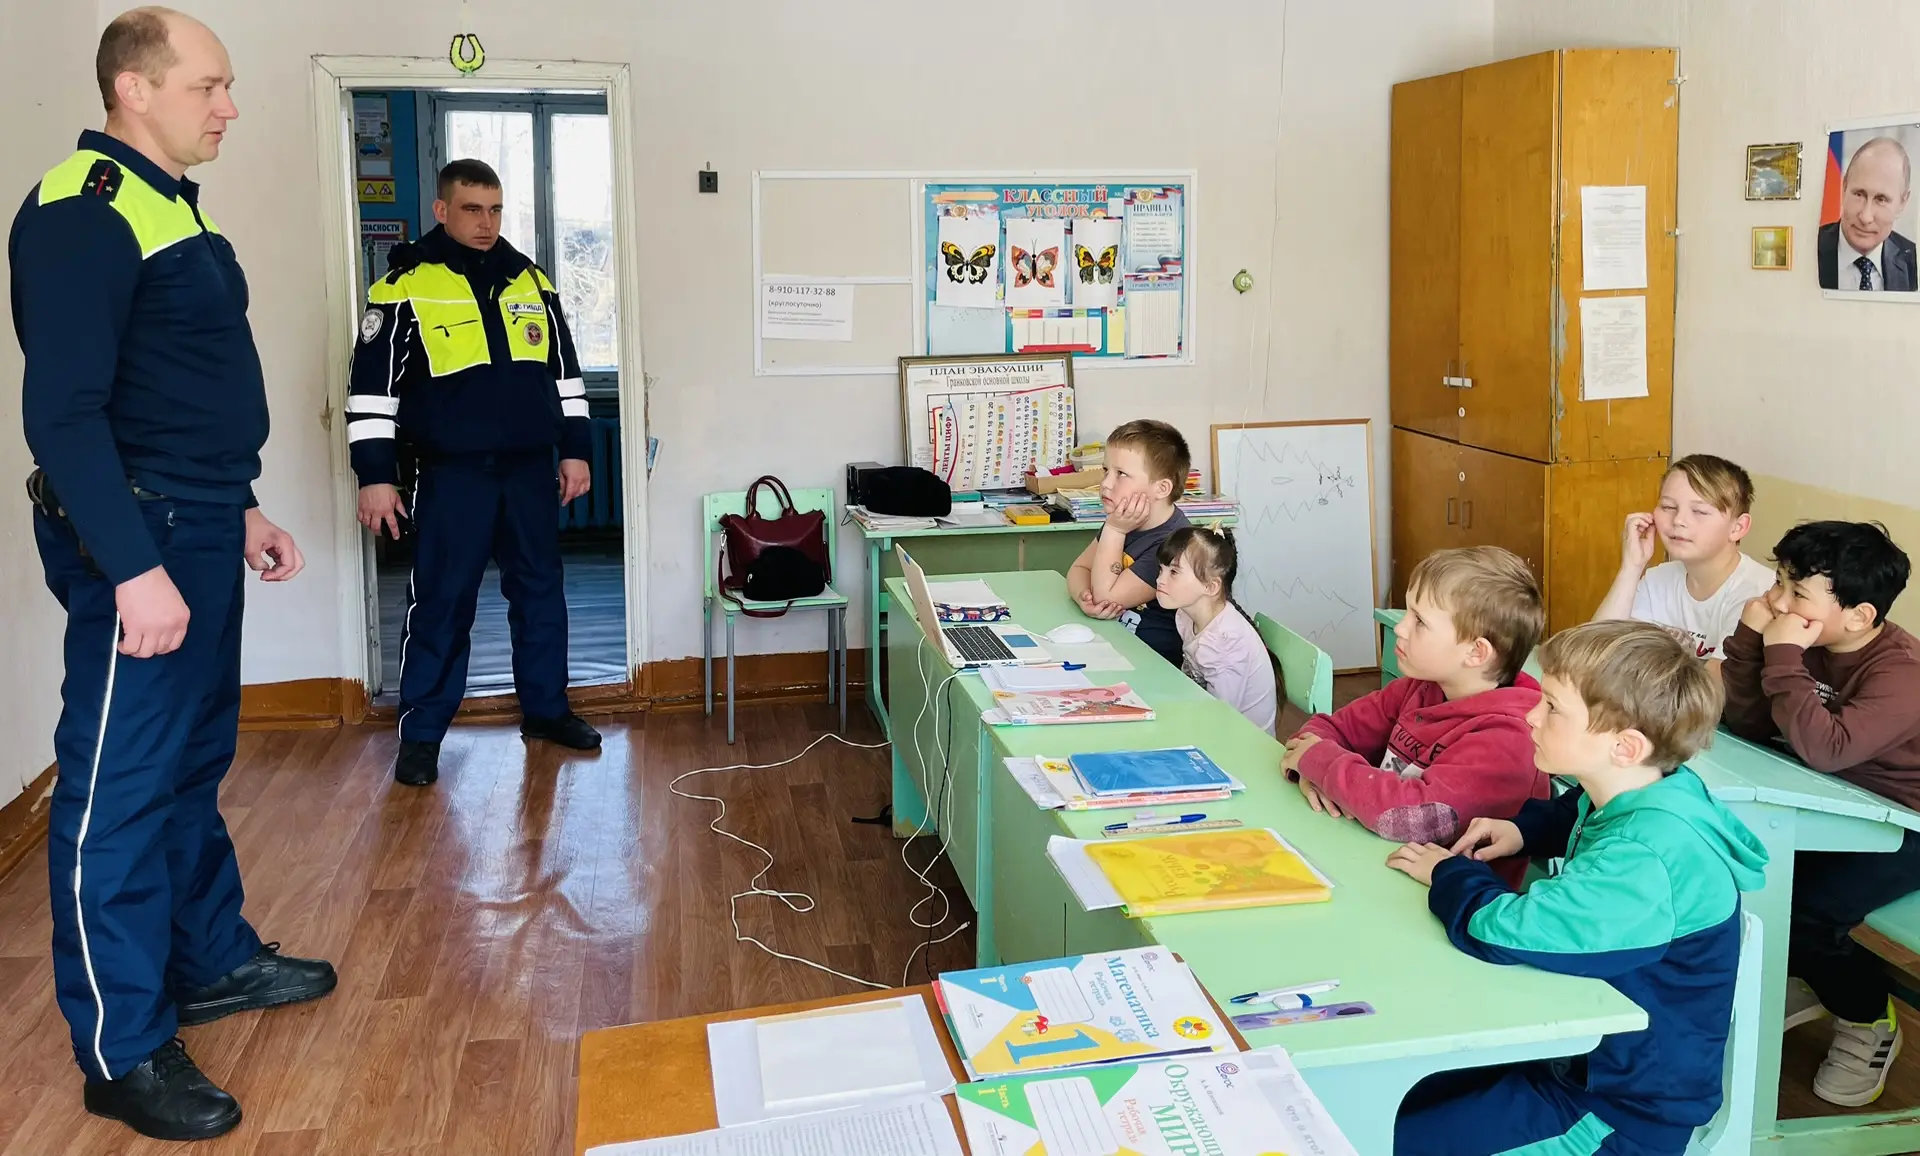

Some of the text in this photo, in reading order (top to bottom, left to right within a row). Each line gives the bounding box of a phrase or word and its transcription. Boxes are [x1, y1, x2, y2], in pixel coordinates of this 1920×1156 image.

[1003, 185, 1109, 203] КЛАССНЫЙ
[1026, 204, 1089, 217] УГОЛОК
[1133, 204, 1173, 212] ПРАВИЛА
[768, 285, 836, 296] 8-910-117-32-88
[768, 300, 822, 309] (круглосуточно)
[930, 364, 1044, 376] ПЛАН ЭВАКУАЦИИ
[982, 374, 1010, 386] основной
[942, 443, 951, 473] ЛЕНТЫ
[1104, 956, 1160, 1038] Математика
[1005, 1028, 1100, 1065] 1
[998, 1085, 1009, 1108] Часть
[1124, 1098, 1146, 1135] Рабочая
[1118, 1111, 1138, 1144] тетрадь
[1149, 1103, 1201, 1156] МИР
